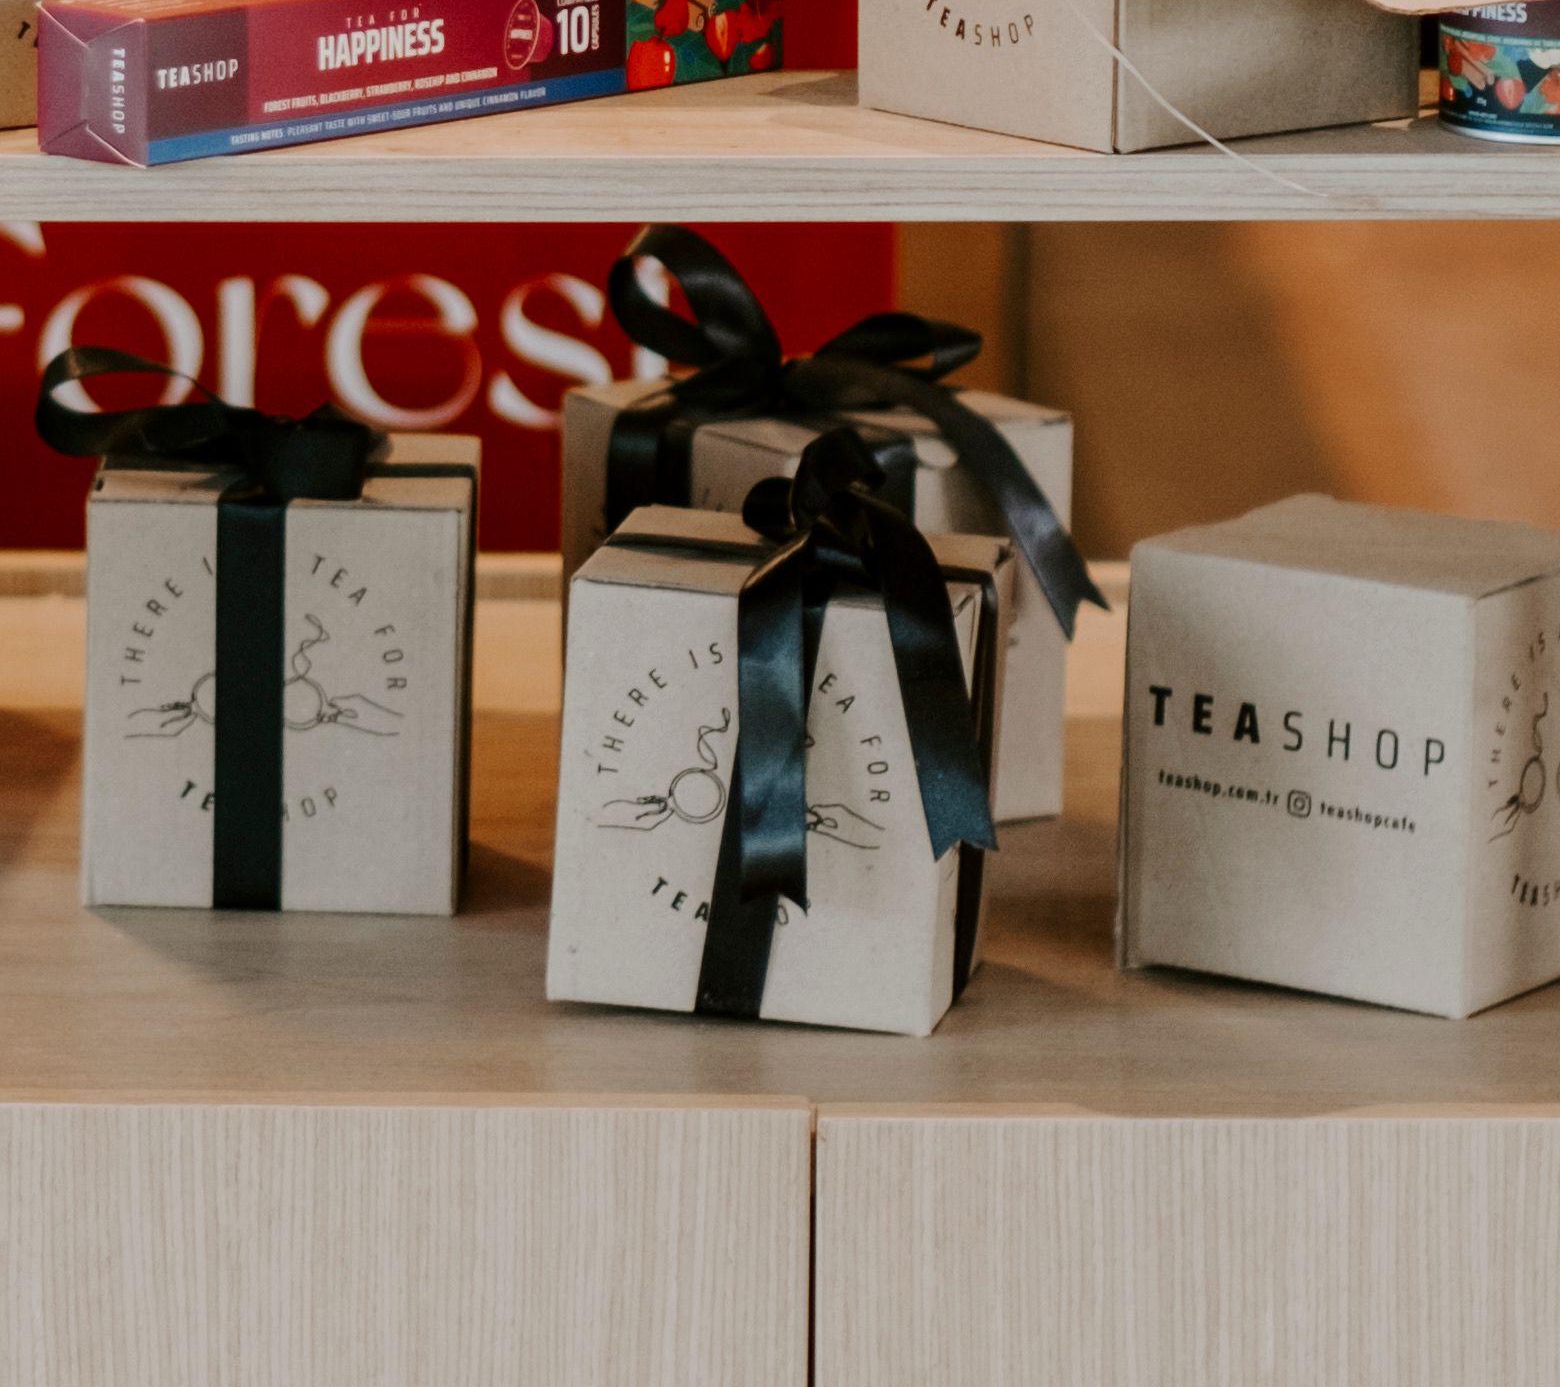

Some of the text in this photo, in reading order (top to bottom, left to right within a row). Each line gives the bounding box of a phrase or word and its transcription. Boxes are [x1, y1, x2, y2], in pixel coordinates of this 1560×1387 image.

[316, 17, 446, 72] HAPPINESS
[345, 6, 421, 30] TEA FOR
[555, 4, 591, 56] 10
[110, 47, 126, 135] TEASHOP
[156, 58, 240, 91] TEASHOP
[230, 131, 259, 146] TASTING
[286, 121, 324, 138] PLEASANT
[325, 118, 346, 131] TASTE
[412, 103, 438, 118] FRUITS
[438, 100, 454, 114] AND
[262, 101, 291, 115] FOREST
[291, 96, 320, 112] FRUITS,
[120, 554, 408, 691] THERE TEA FOR
[597, 642, 891, 804] THERE IS EA FOR
[1148, 684, 1448, 777] TEASHOP
[1487, 673, 1522, 789] THERE
[1529, 630, 1546, 664] IS
[1156, 767, 1281, 809] teashop.com.tr
